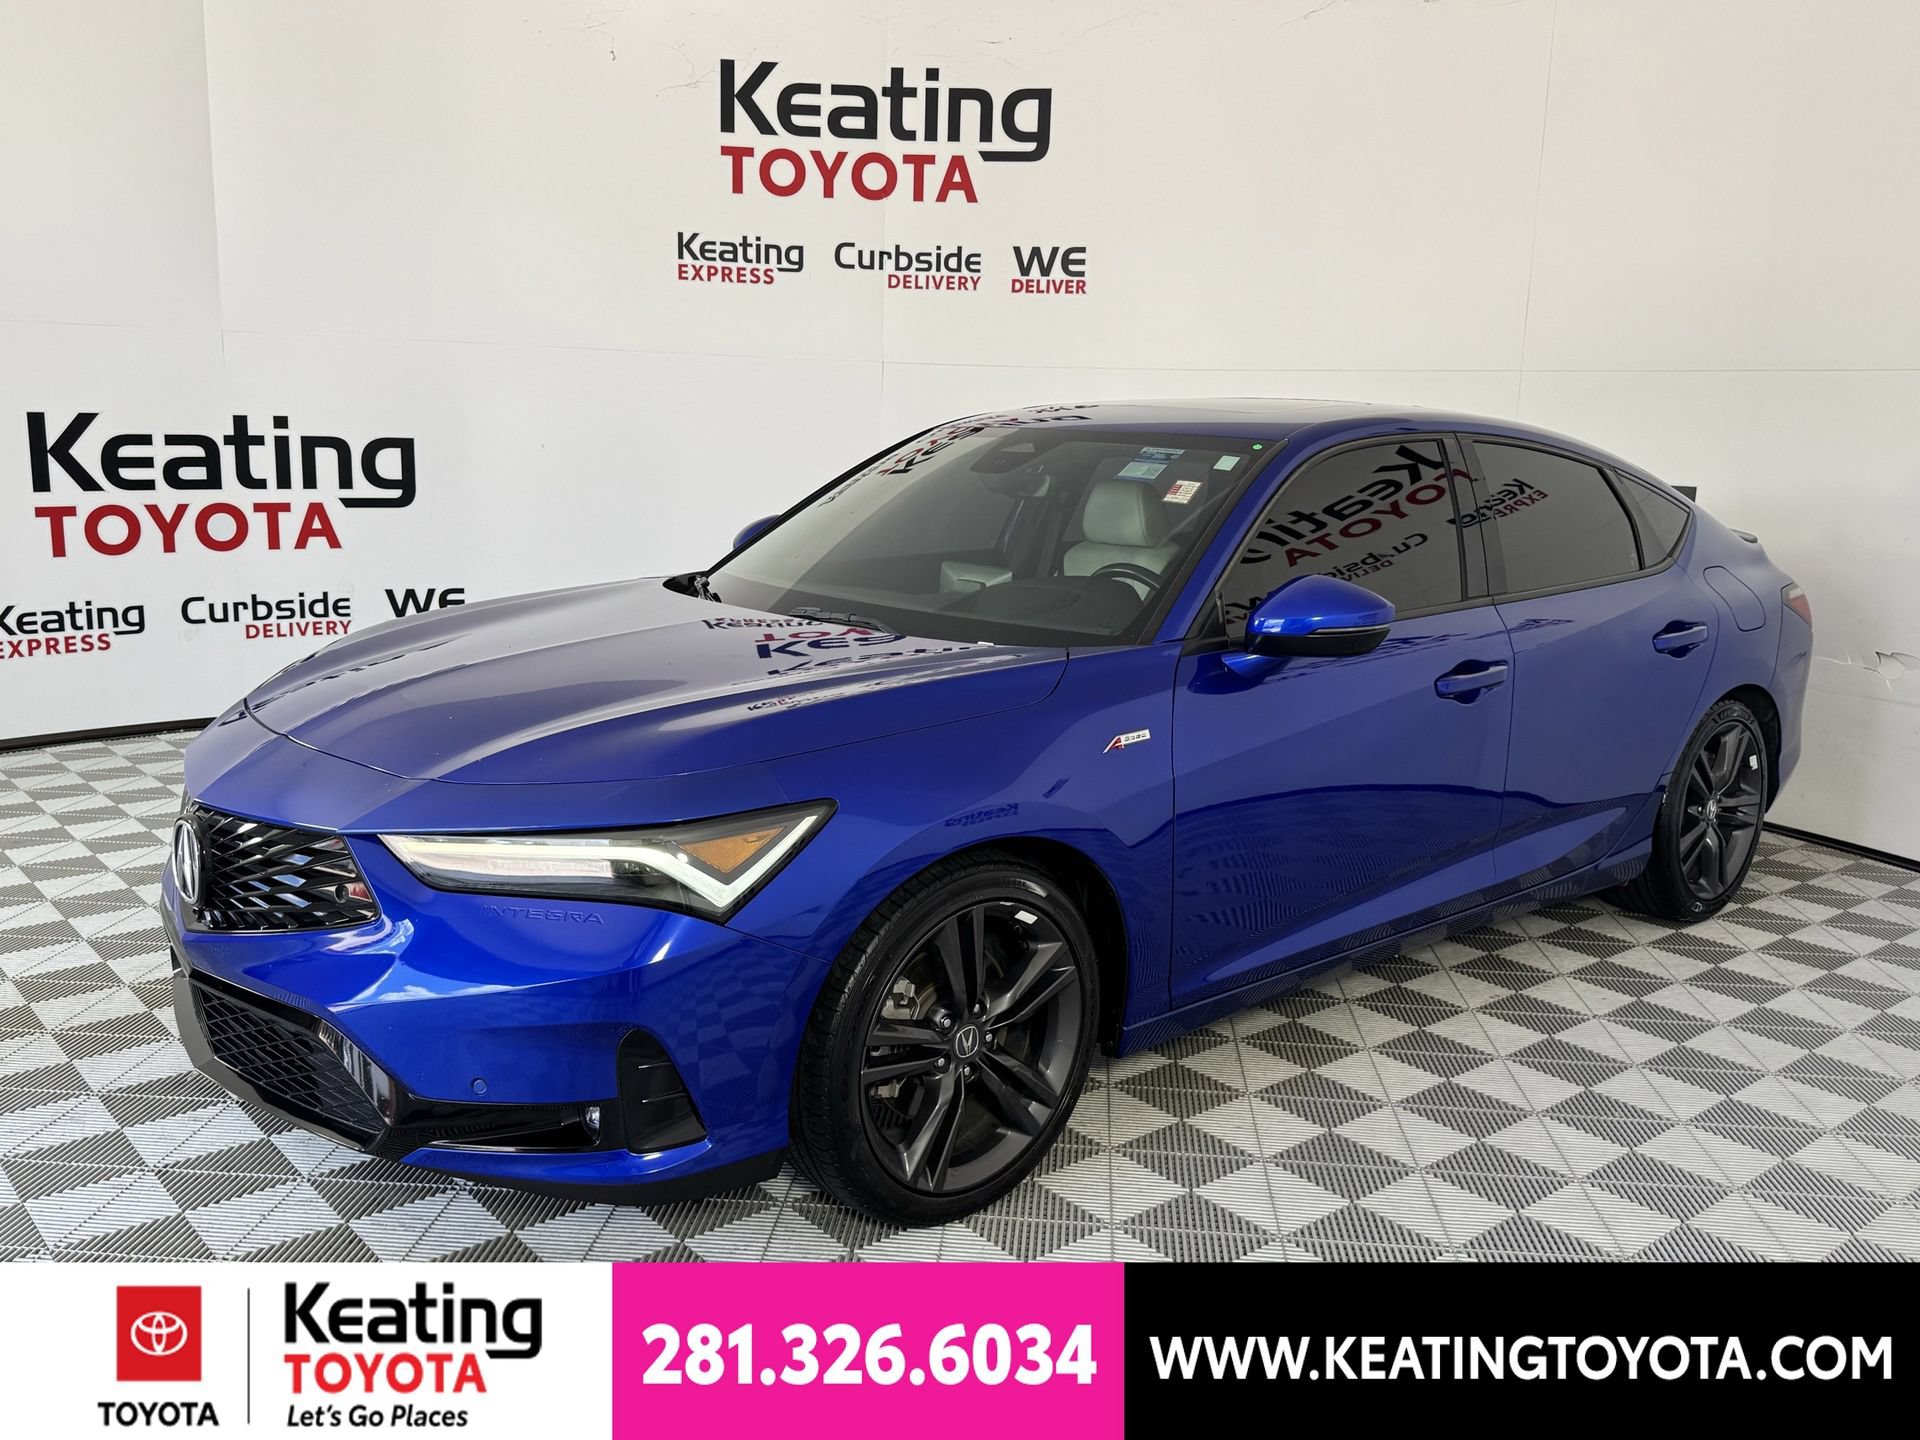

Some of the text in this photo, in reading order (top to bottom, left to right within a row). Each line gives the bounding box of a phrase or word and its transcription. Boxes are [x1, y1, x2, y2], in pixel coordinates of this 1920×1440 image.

[719, 58, 1053, 163] Keating
[720, 145, 979, 204] TOYOTA
[677, 231, 804, 273] Keating
[834, 242, 982, 274] Curbside
[1012, 245, 1087, 278] WE
[677, 263, 775, 285] EXPRESS
[888, 274, 982, 291] DELIVERY
[1011, 278, 1087, 295] DELIVER
[26, 411, 417, 509] Keating
[35, 501, 343, 559] TOYOTA
[0, 600, 146, 636] Keating
[180, 591, 352, 625] Curbside
[384, 587, 466, 618] WE
[245, 619, 353, 640] DELIVERY
[480, 904, 606, 926] INTEGRA
